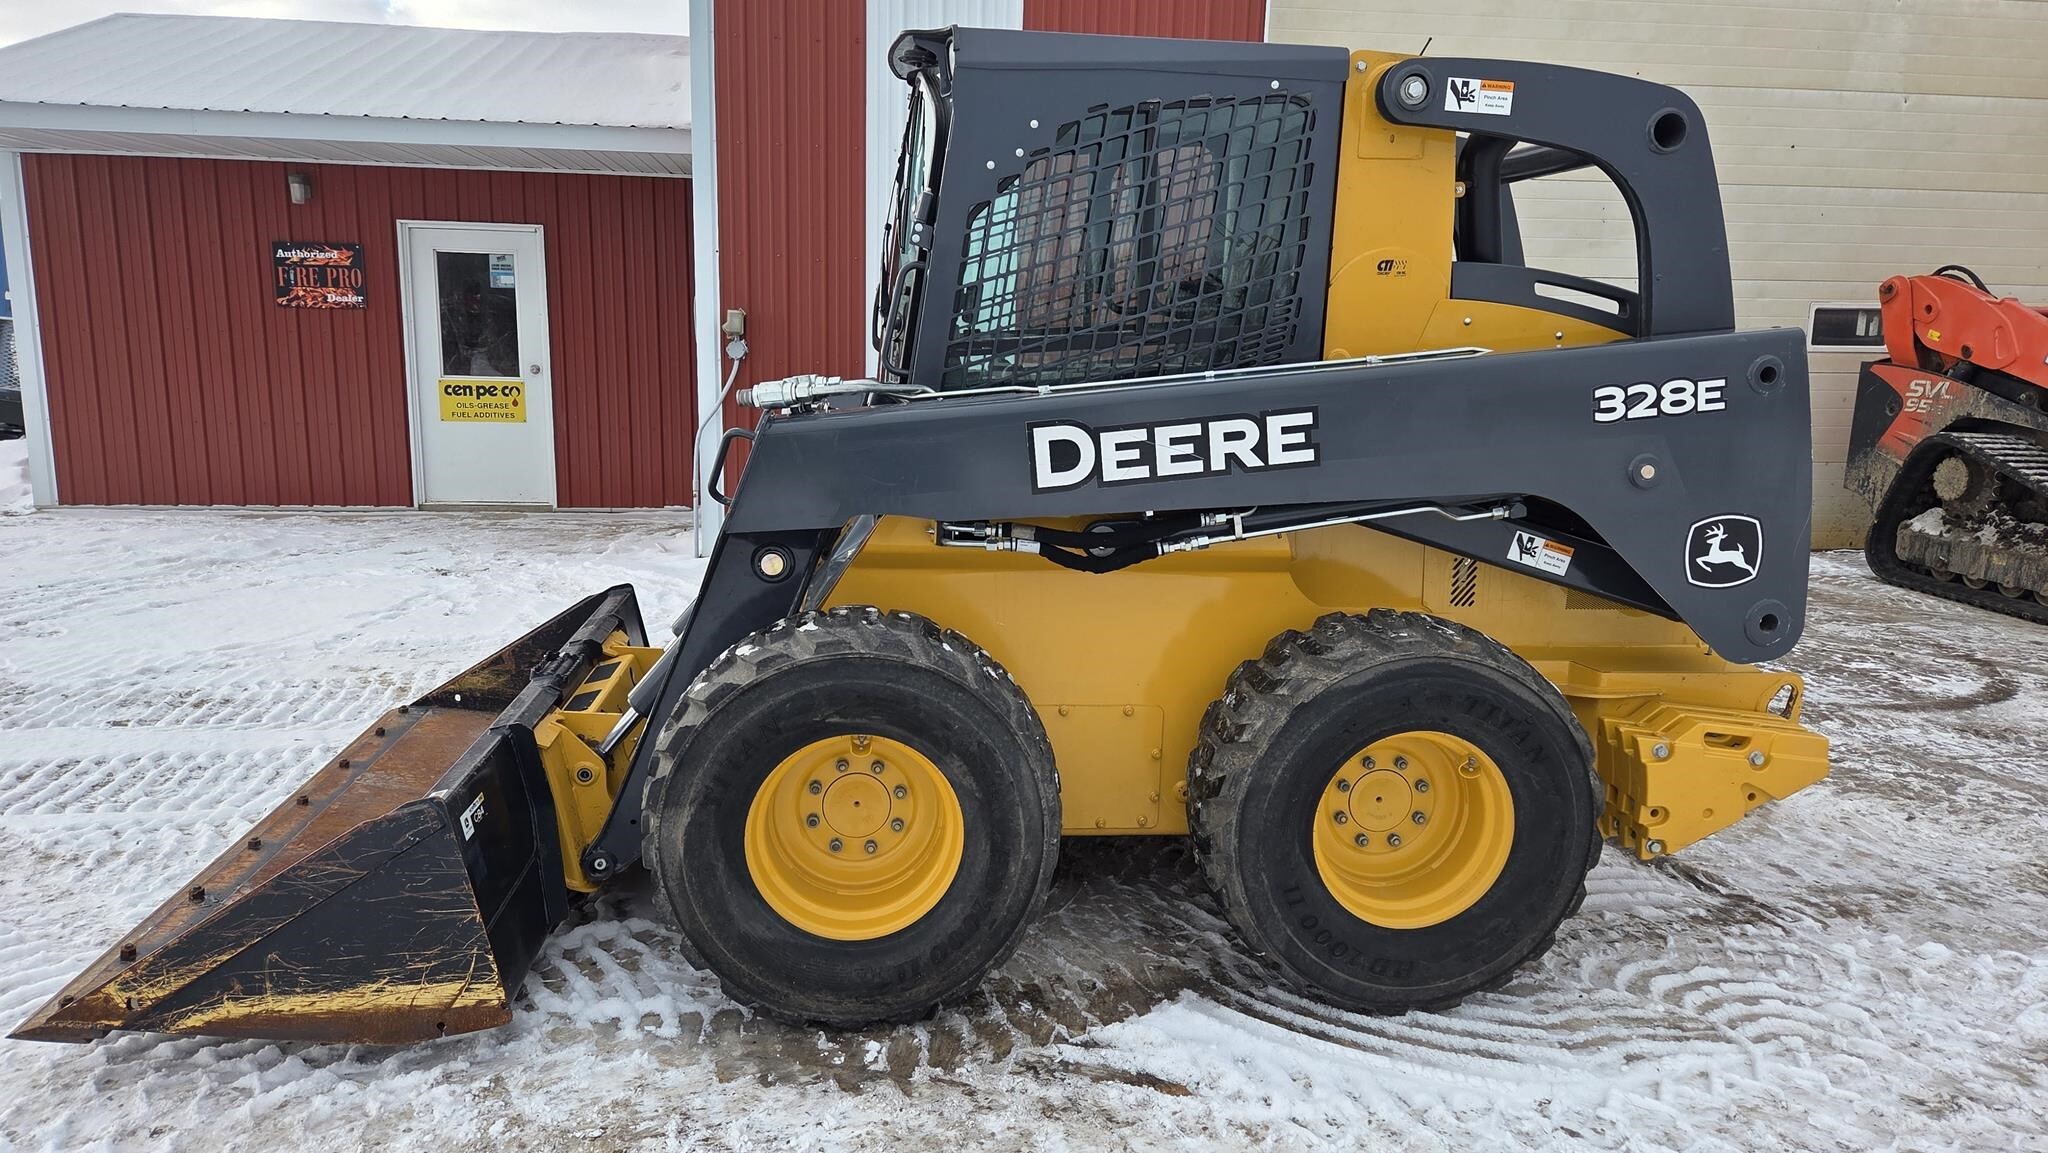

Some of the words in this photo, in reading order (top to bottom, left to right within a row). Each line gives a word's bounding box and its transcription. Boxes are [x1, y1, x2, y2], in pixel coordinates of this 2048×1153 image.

[276, 248, 338, 259] Authorized
[326, 267, 362, 289] PRO
[326, 293, 364, 303] Dealer
[1594, 378, 1726, 422] 328E
[1032, 411, 1315, 489] DEERE
